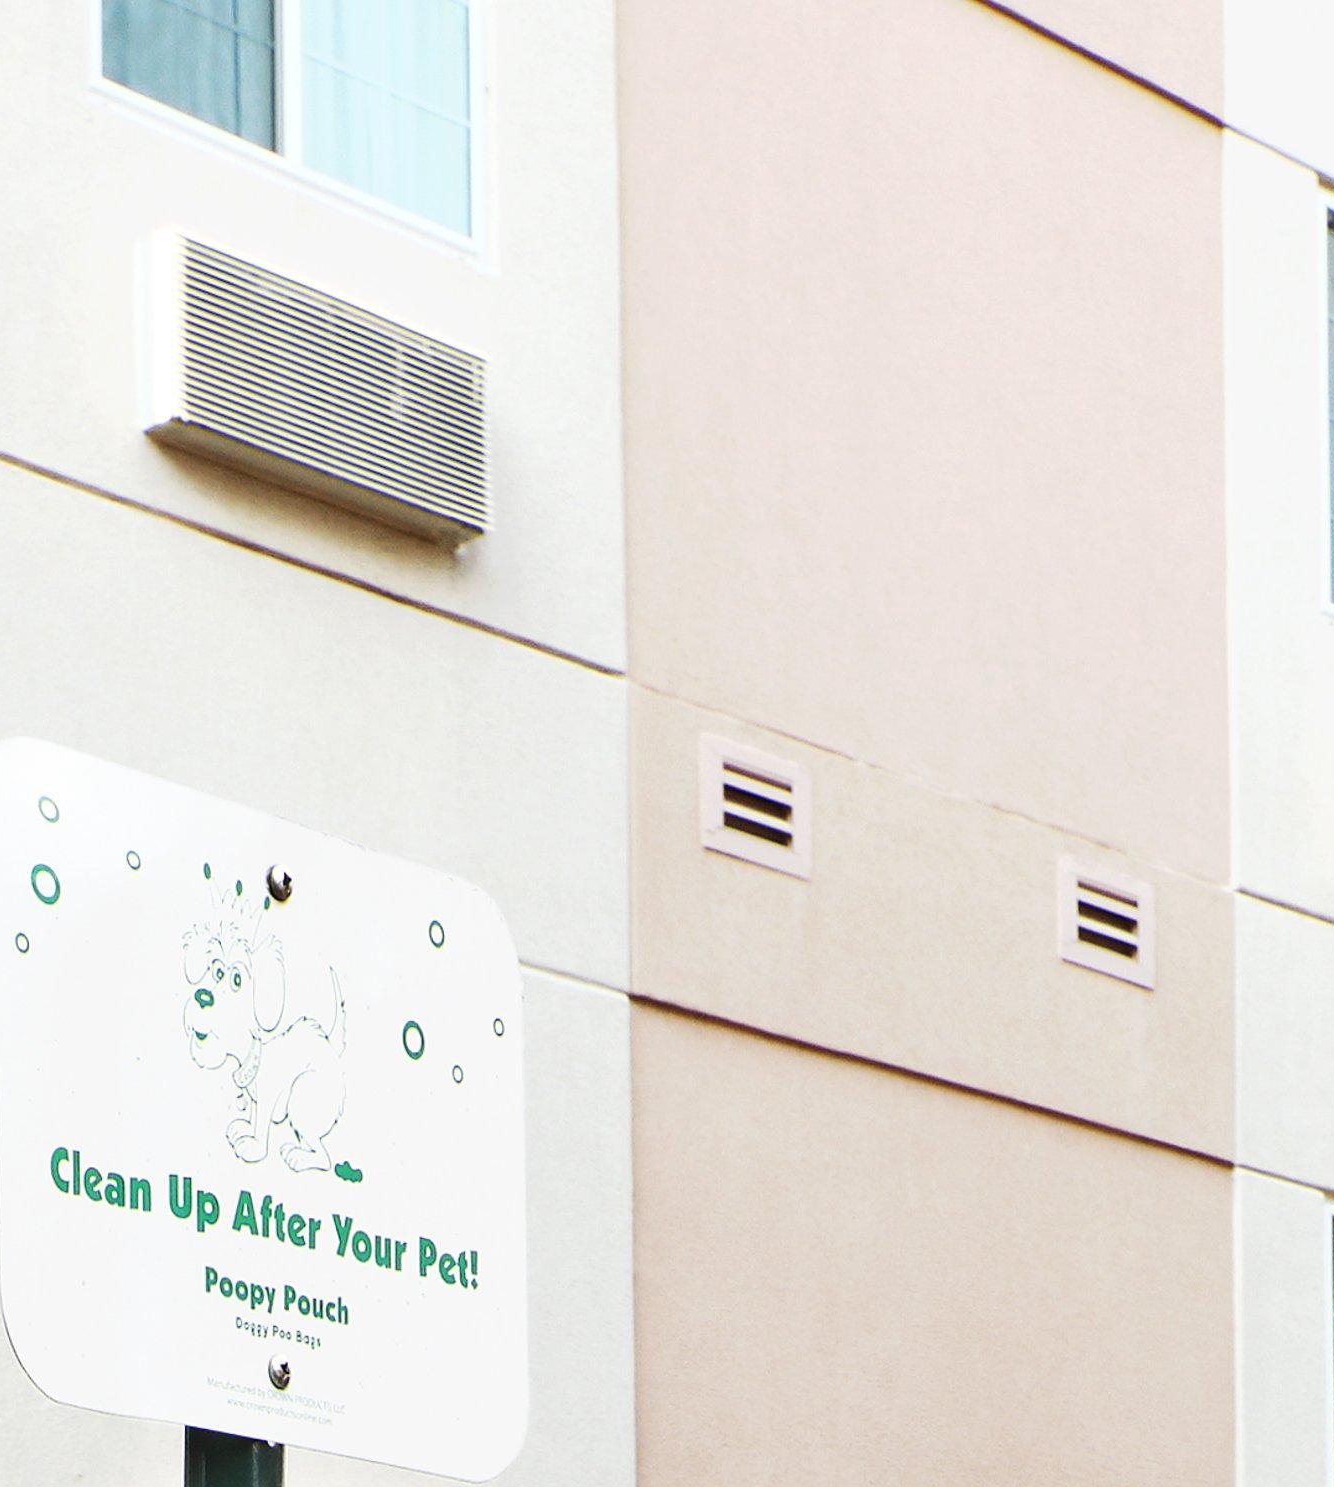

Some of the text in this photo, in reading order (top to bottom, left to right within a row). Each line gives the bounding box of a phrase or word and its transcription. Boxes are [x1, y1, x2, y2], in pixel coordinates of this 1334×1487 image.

[50, 1146, 479, 1290] Clean Up After Your Pet!
[205, 1266, 349, 1325] Poopy Pouch
[235, 1316, 322, 1350] Doggy Poo Bags
[207, 1376, 256, 1397] Manufactured
[257, 1387, 266, 1400] by
[267, 1389, 293, 1404] CROWN
